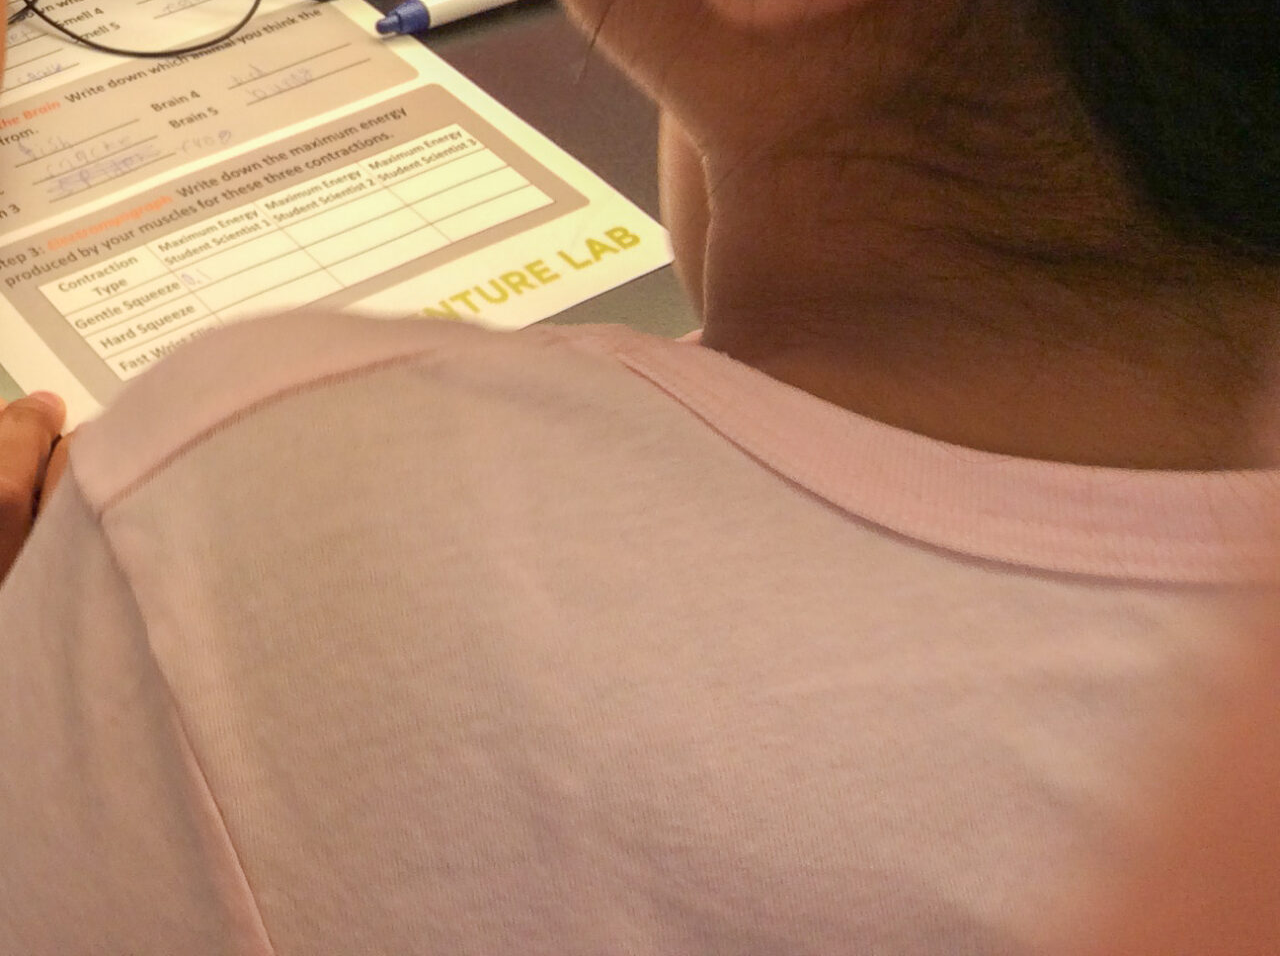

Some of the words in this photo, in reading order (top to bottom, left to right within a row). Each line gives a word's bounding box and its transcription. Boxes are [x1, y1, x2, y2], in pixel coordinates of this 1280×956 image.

[23, 100, 61, 120] Brain
[64, 84, 106, 104] Write
[107, 70, 148, 90] down
[148, 53, 189, 74] which
[236, 29, 263, 45] you
[263, 16, 297, 34] think
[297, 8, 323, 21] the
[150, 94, 189, 113] Brain
[189, 89, 201, 100] 4
[168, 111, 207, 130] Brain
[207, 107, 219, 117] 5
[175, 176, 219, 198] Write
[221, 161, 262, 182] down
[262, 151, 288, 166] the
[289, 126, 359, 157] maximum
[359, 107, 408, 132] energy
[369, 145, 424, 170] Maximum
[423, 130, 463, 149] Energy
[377, 161, 422, 182] Student
[421, 142, 470, 163] Scientist
[4, 248, 78, 288] produced
[78, 243, 100, 258] by
[102, 230, 136, 251] your
[138, 204, 198, 234] muscles
[197, 194, 221, 210] for
[221, 181, 263, 200] these
[263, 165, 304, 185] three
[304, 132, 394, 170] contractions.
[8, 203, 21, 214] 3
[264, 183, 322, 210] Maximum
[322, 169, 361, 189] Energy
[273, 200, 318, 223] Student
[318, 182, 367, 204] Scientist
[158, 226, 218, 252] Maximum
[218, 209, 258, 229] Energy
[164, 241, 212, 265] Student
[212, 222, 261, 245] Scientist
[556, 225, 641, 271] LAB
[58, 255, 139, 293] Contraction
[93, 277, 128, 297] Type
[74, 305, 122, 330] Gentle
[122, 280, 182, 310] Squeeze
[99, 328, 137, 350] Hard
[136, 304, 196, 334] Squeeze
[119, 352, 151, 372] Fast
